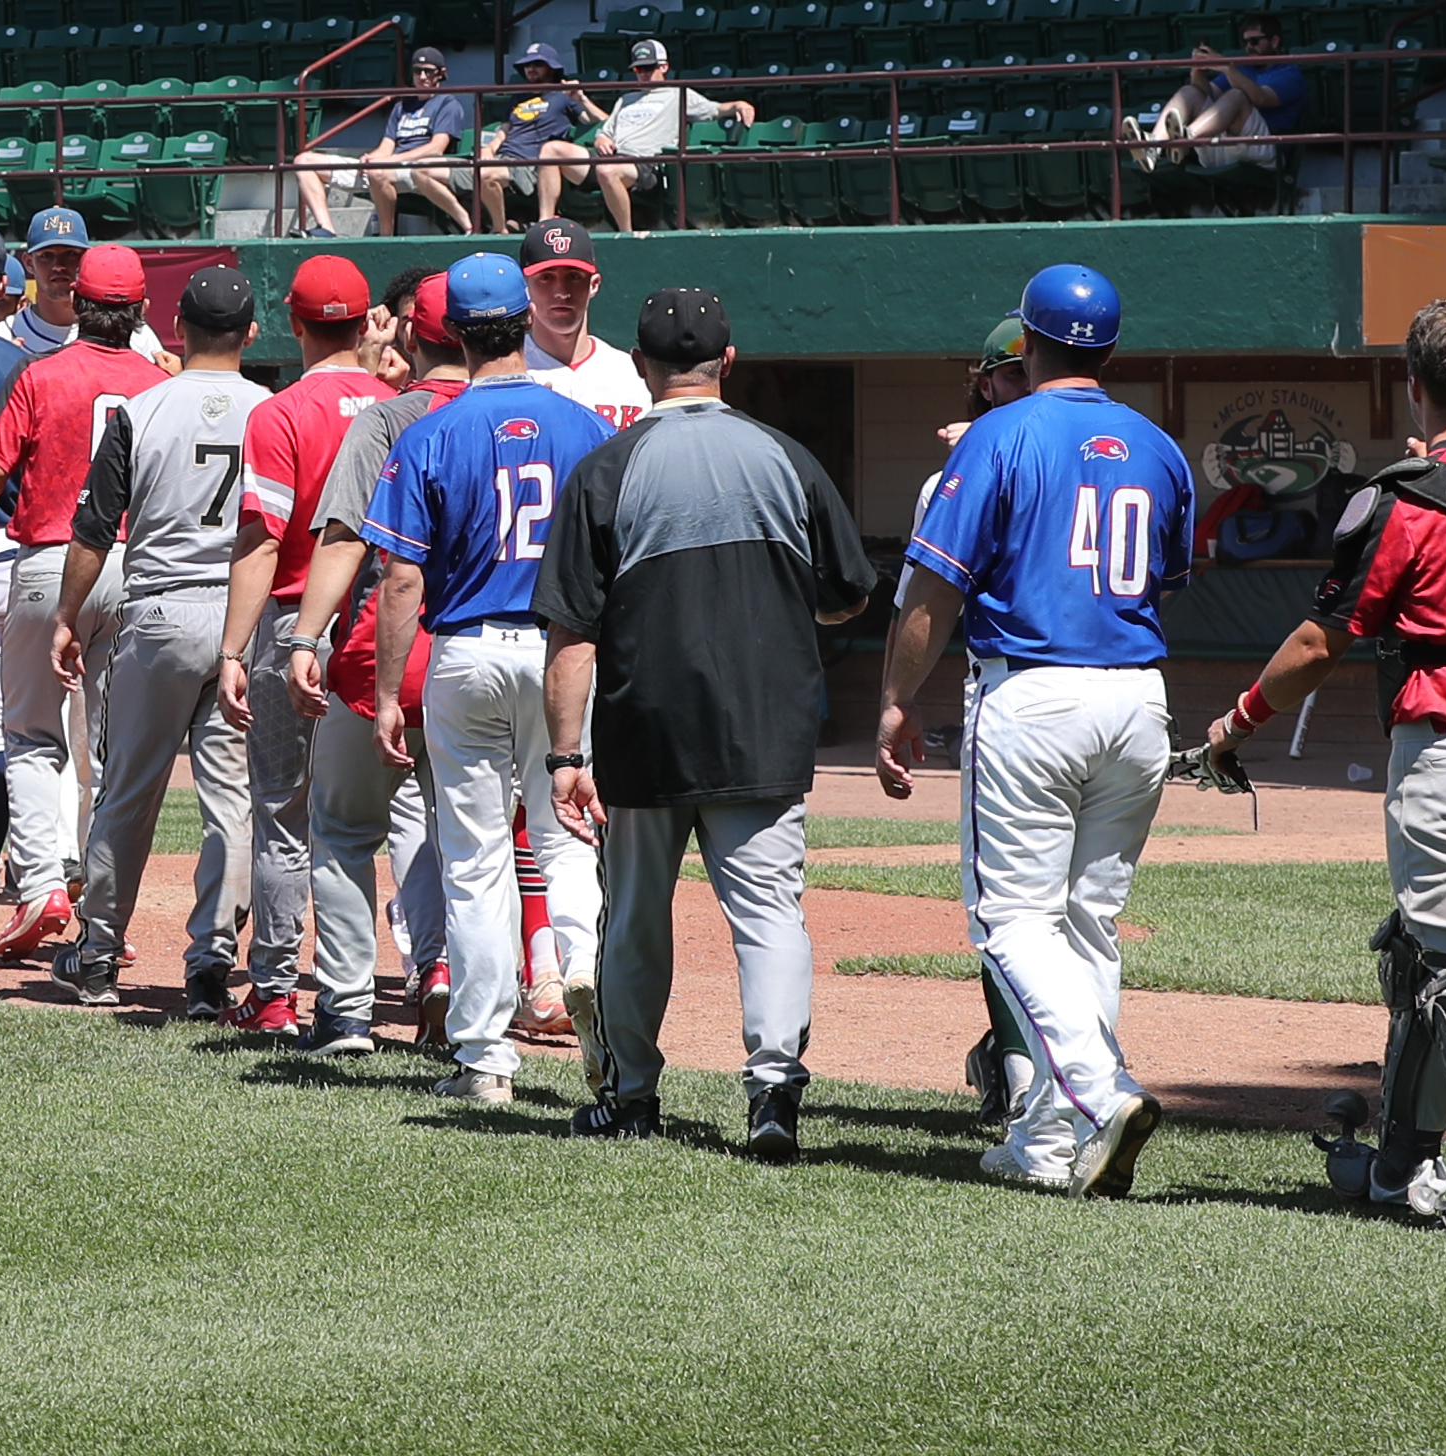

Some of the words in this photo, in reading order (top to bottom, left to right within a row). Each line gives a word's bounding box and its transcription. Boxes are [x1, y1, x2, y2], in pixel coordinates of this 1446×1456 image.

[1272, 388, 1335, 422] STADIUM
[195, 443, 241, 528] 7
[495, 461, 554, 562] 12
[1069, 484, 1153, 598] 40
